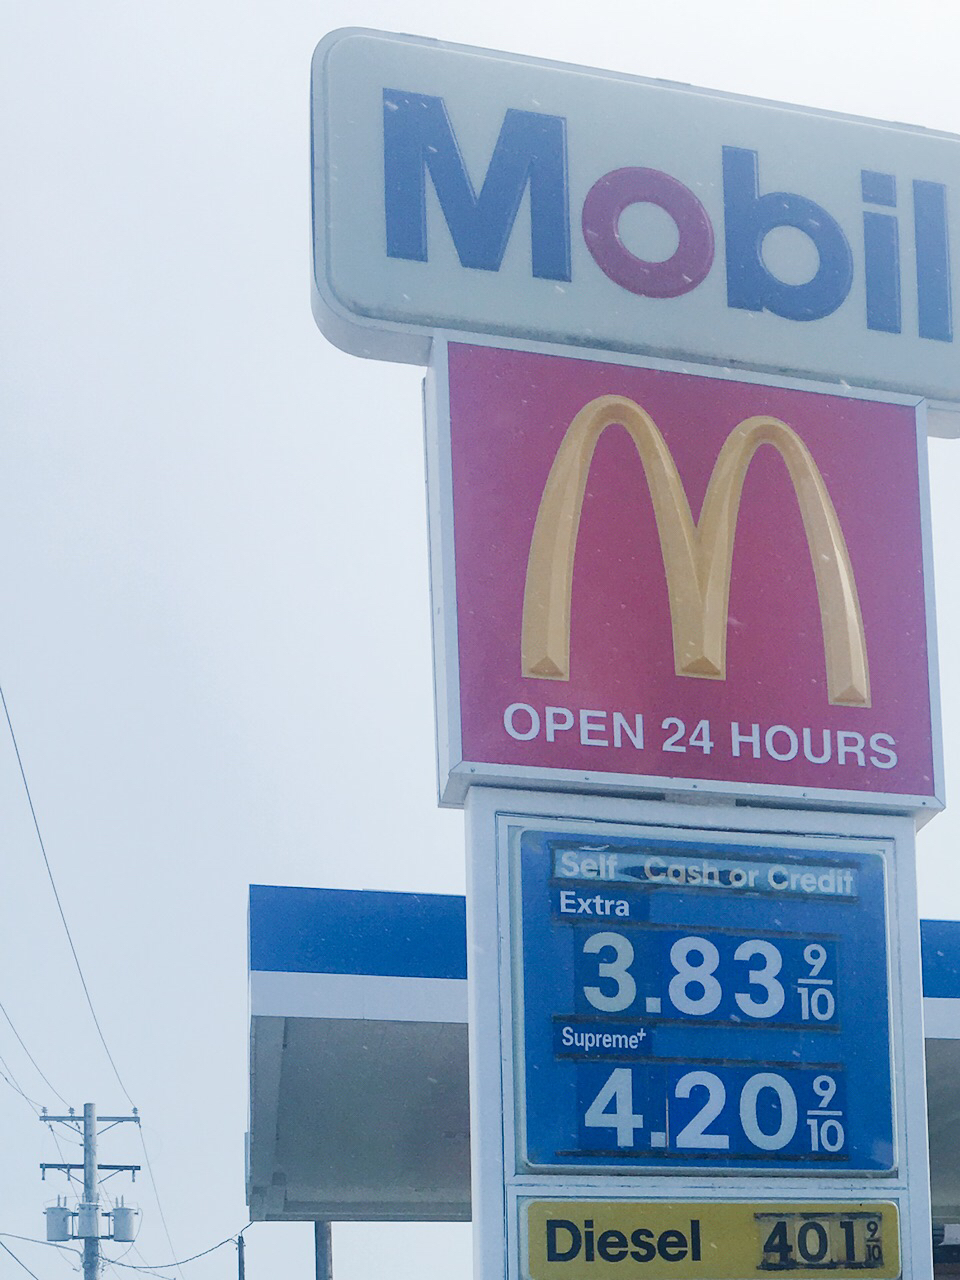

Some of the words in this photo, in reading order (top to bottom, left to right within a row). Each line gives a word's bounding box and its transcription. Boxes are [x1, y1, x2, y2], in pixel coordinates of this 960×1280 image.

[382, 88, 953, 343] Mobil
[503, 703, 645, 750] OPEN
[661, 716, 714, 755] 24
[731, 722, 898, 770] HOURS
[559, 890, 630, 917] Extra
[560, 850, 618, 880] Self
[644, 856, 719, 887] Cash
[729, 867, 760, 888] or
[767, 865, 854, 894] Credit
[582, 931, 786, 1019] 3.83
[584, 1067, 798, 1151] 4.20
[545, 1218, 702, 1263] Diesel
[762, 1220, 857, 1266] 401
